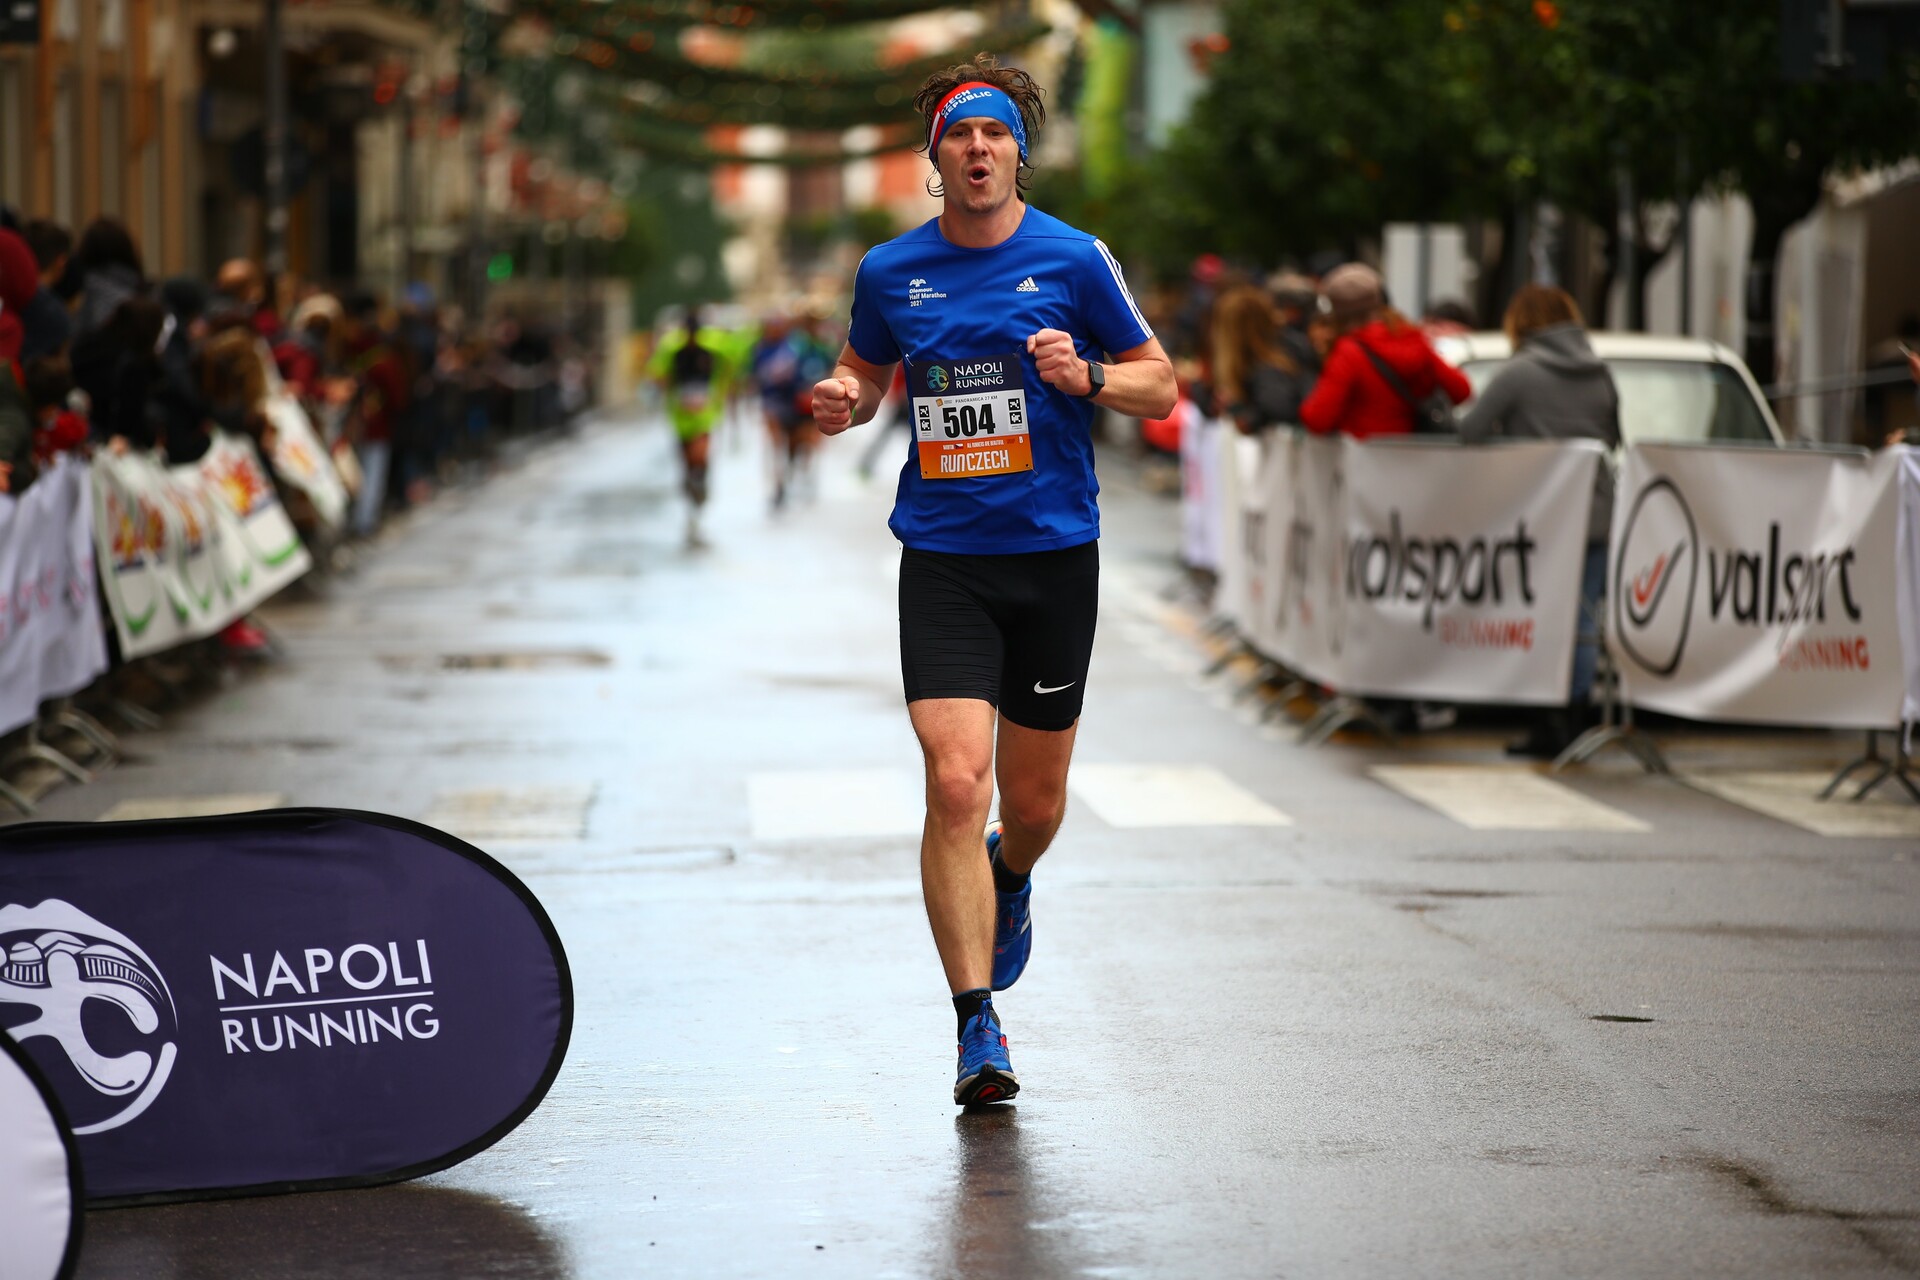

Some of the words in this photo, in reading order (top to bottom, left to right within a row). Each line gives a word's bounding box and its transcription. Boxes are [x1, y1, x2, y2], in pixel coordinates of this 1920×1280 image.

[941, 89, 971, 116] CZECH
[944, 91, 992, 118] REPUBLIC
[954, 361, 1003, 377] NAPOLI
[955, 375, 1004, 389] RUNNING
[942, 403, 996, 438] 504
[209, 939, 432, 1000] NAPOLI
[221, 1003, 440, 1054] RUNNING
